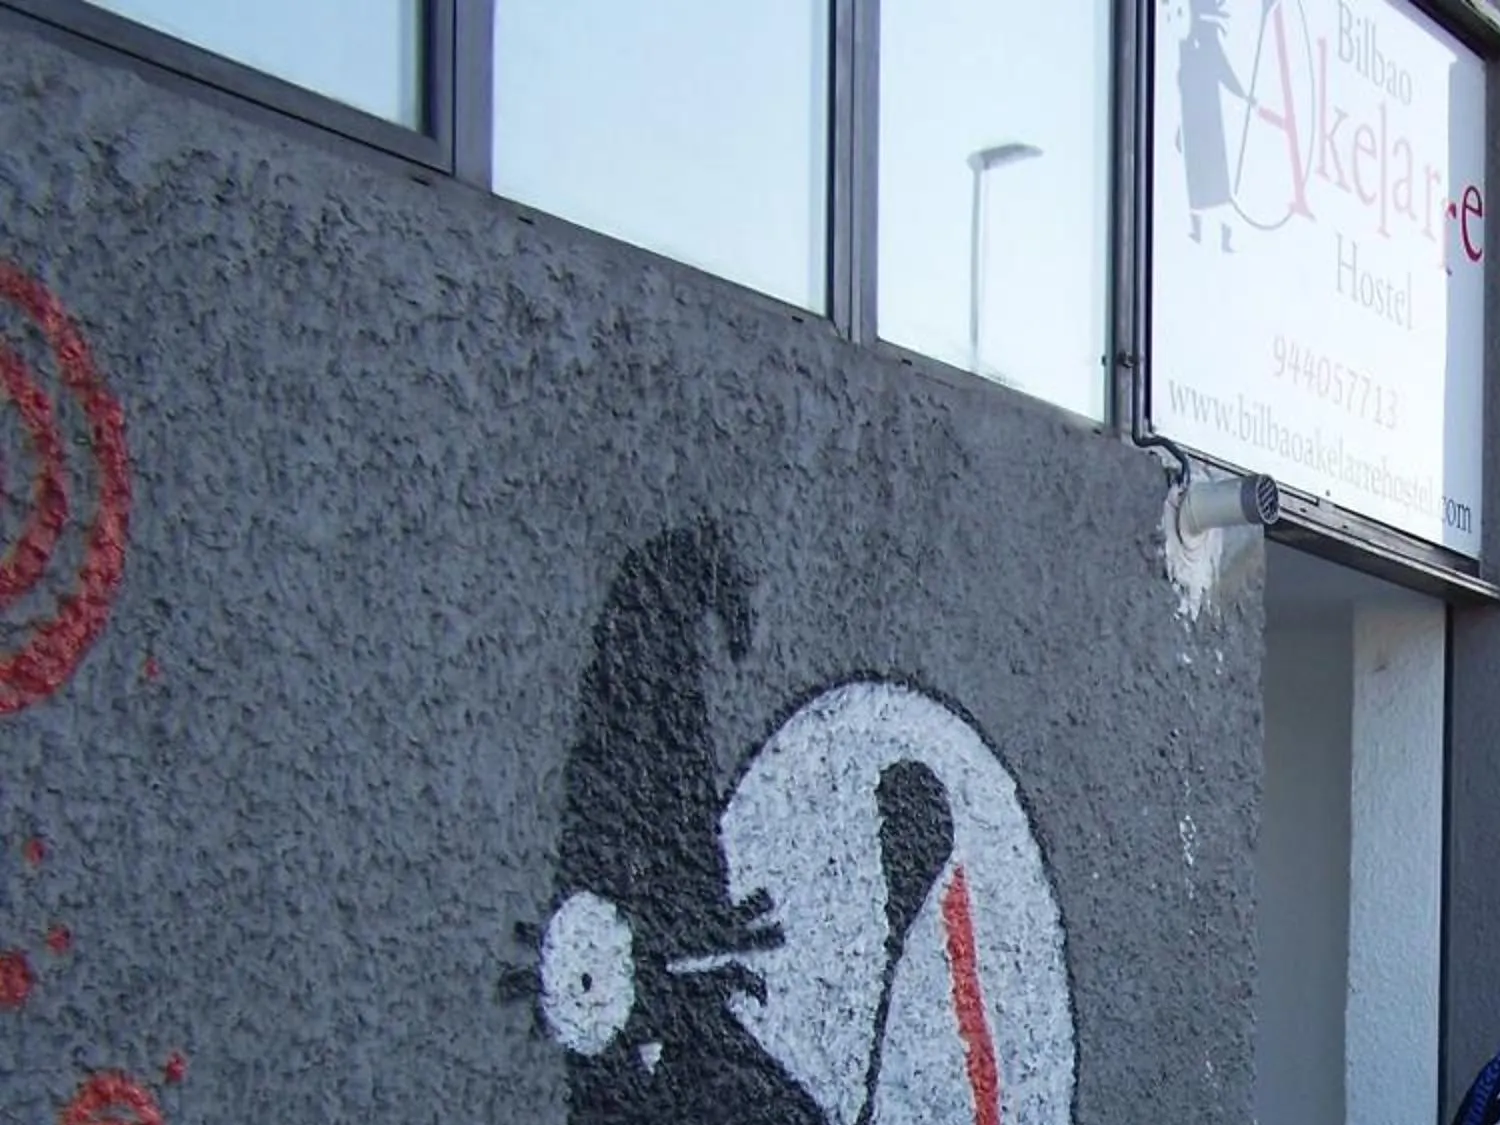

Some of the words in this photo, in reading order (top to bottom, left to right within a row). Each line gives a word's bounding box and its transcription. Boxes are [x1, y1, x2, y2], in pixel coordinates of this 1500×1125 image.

[1337, 0, 1413, 105] Bilbao
[1233, 0, 1484, 275] Akelarre
[1337, 230, 1413, 331] Hostel
[1272, 335, 1398, 431] 944057713
